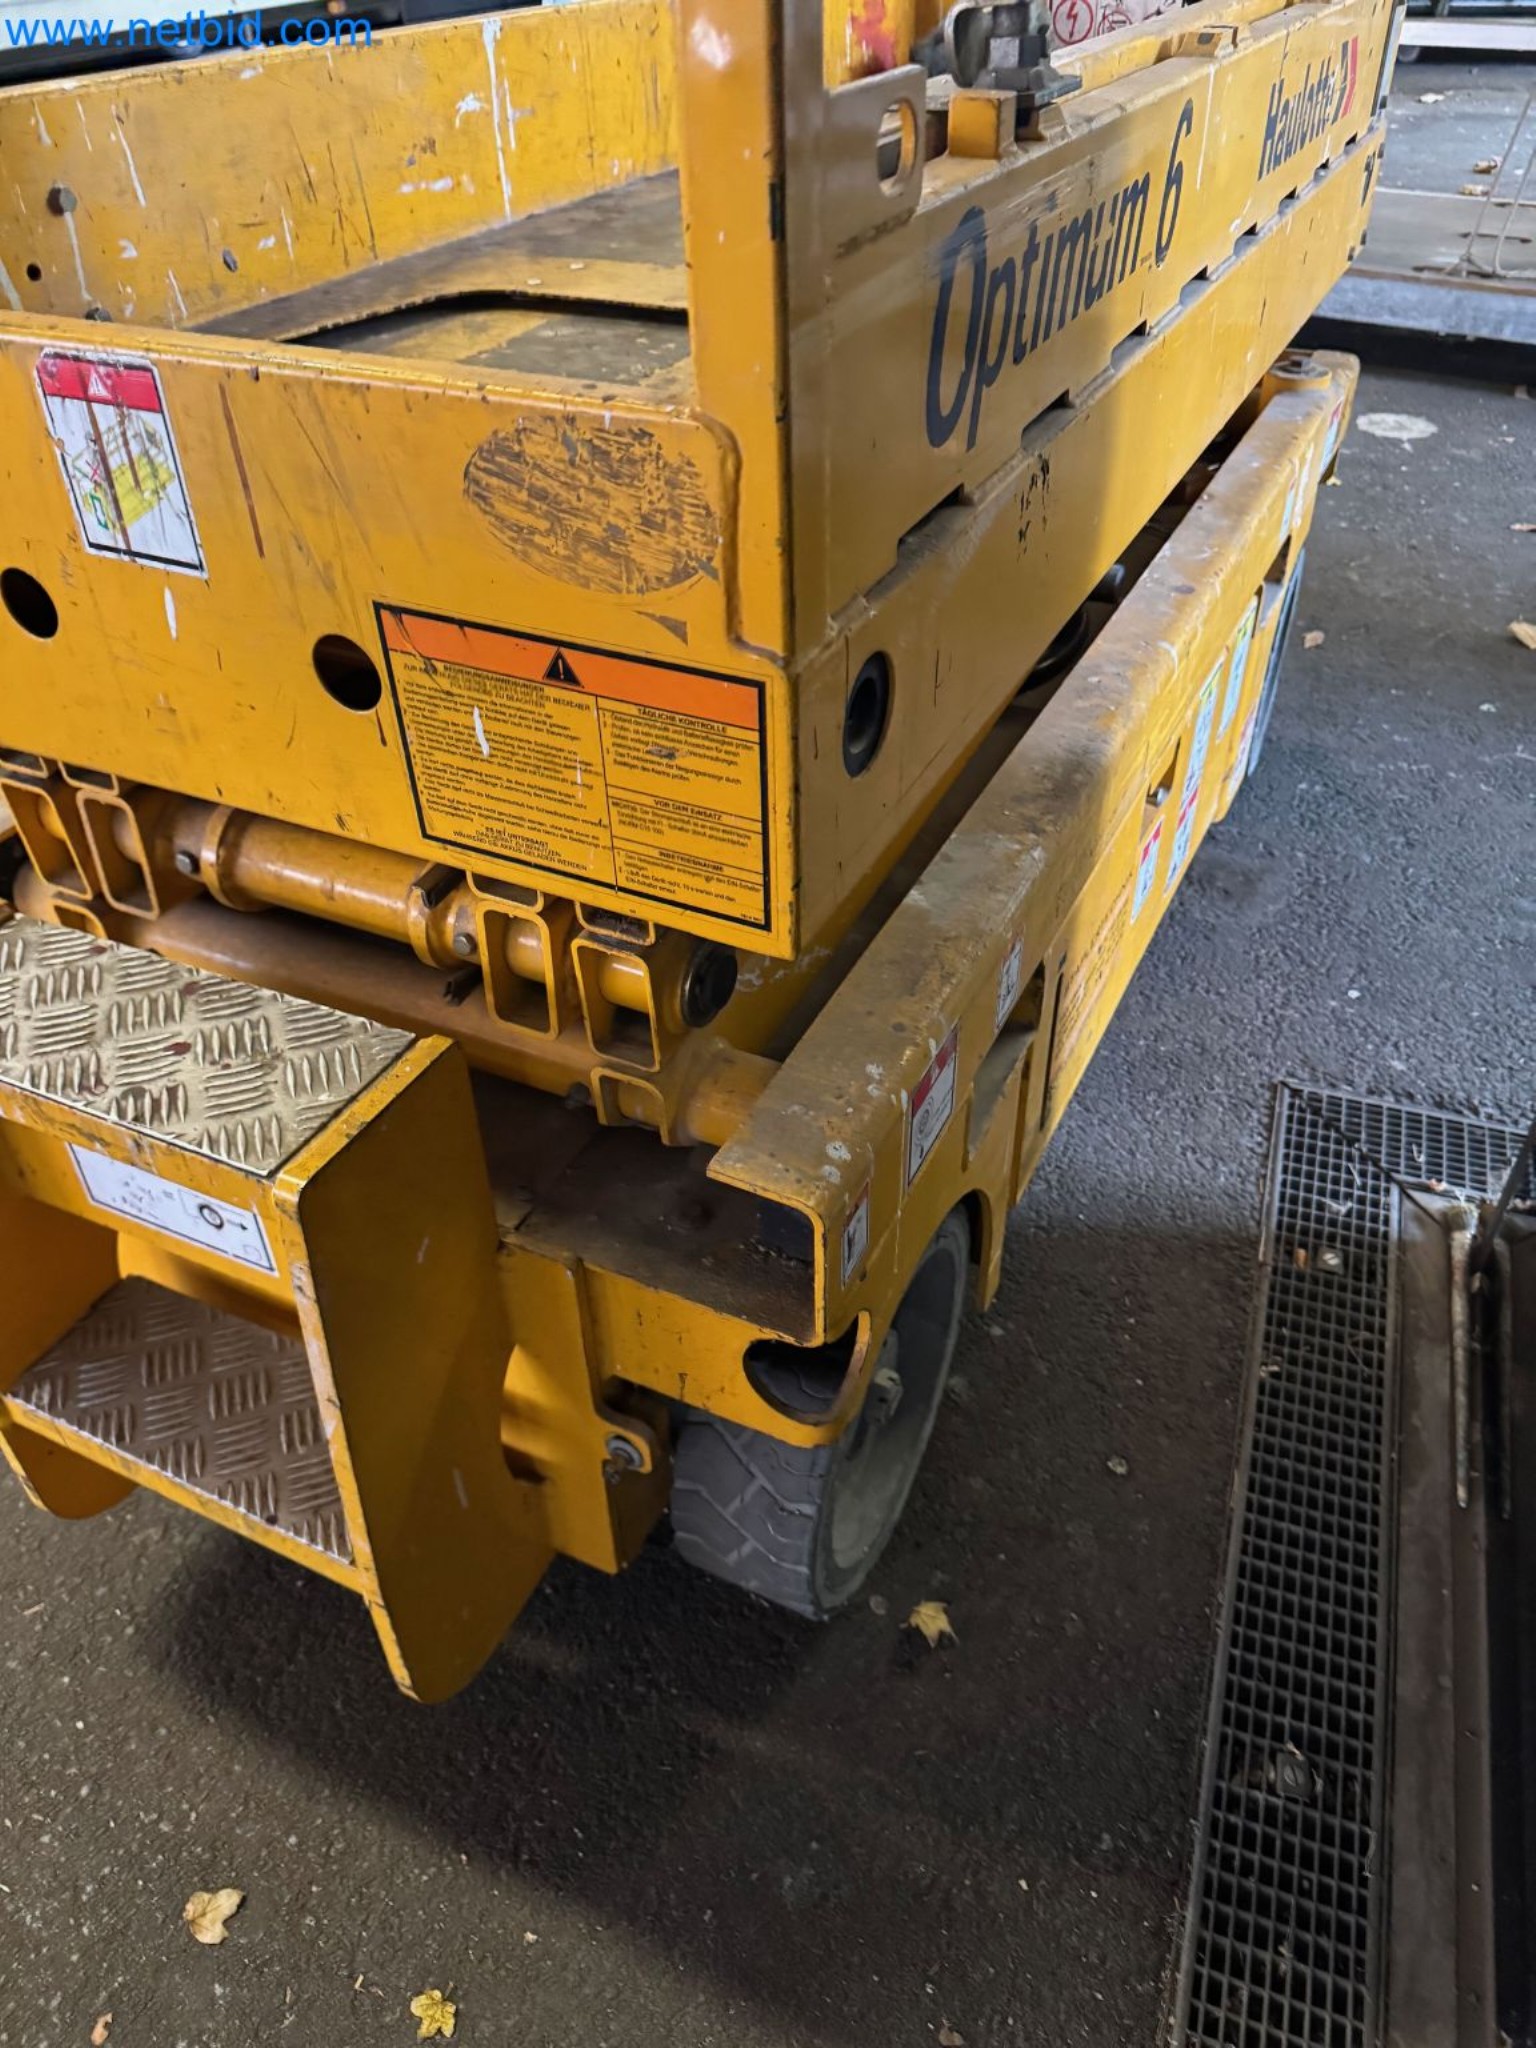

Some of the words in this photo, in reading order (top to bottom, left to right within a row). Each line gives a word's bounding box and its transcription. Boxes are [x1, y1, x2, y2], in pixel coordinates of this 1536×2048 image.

[926, 172, 1151, 452] Optimum
[1156, 99, 1194, 268] 6
[678, 716, 726, 733] KONTROLLE
[653, 799, 669, 808] VOR
[671, 803, 688, 813] DEM
[690, 807, 721, 821] EINSATZ
[557, 857, 586, 871] WERDEN
